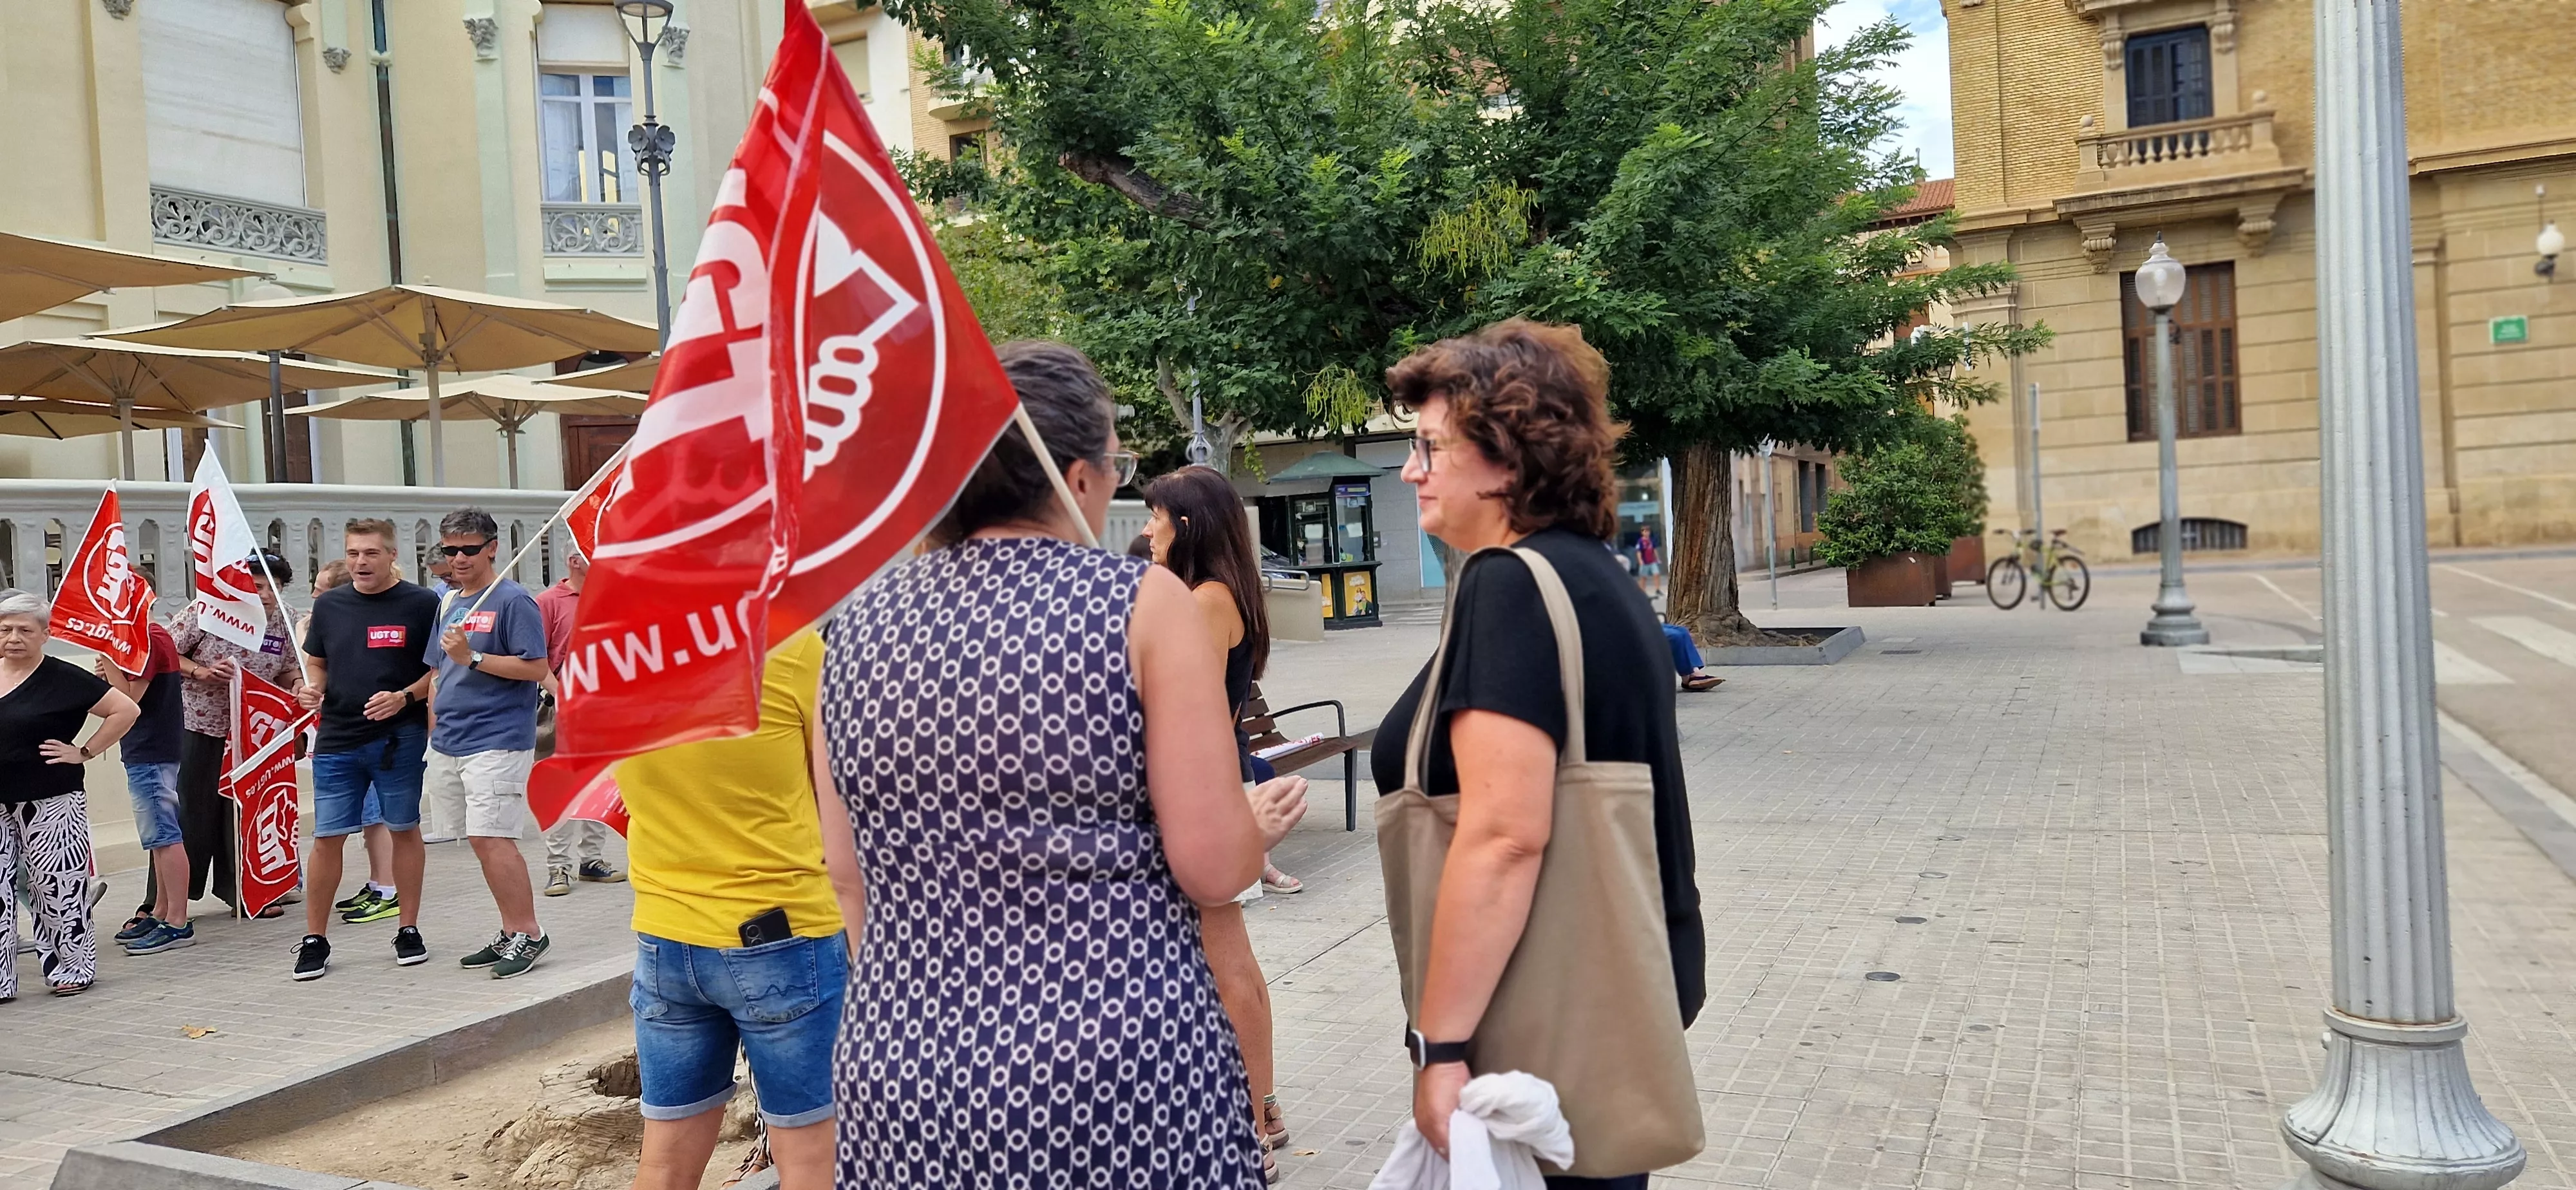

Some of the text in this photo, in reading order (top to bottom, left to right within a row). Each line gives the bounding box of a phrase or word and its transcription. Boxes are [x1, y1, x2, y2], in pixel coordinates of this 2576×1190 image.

[370, 630, 390, 639] UGT
[249, 706, 287, 750] GT
[256, 802, 286, 876] UGT
